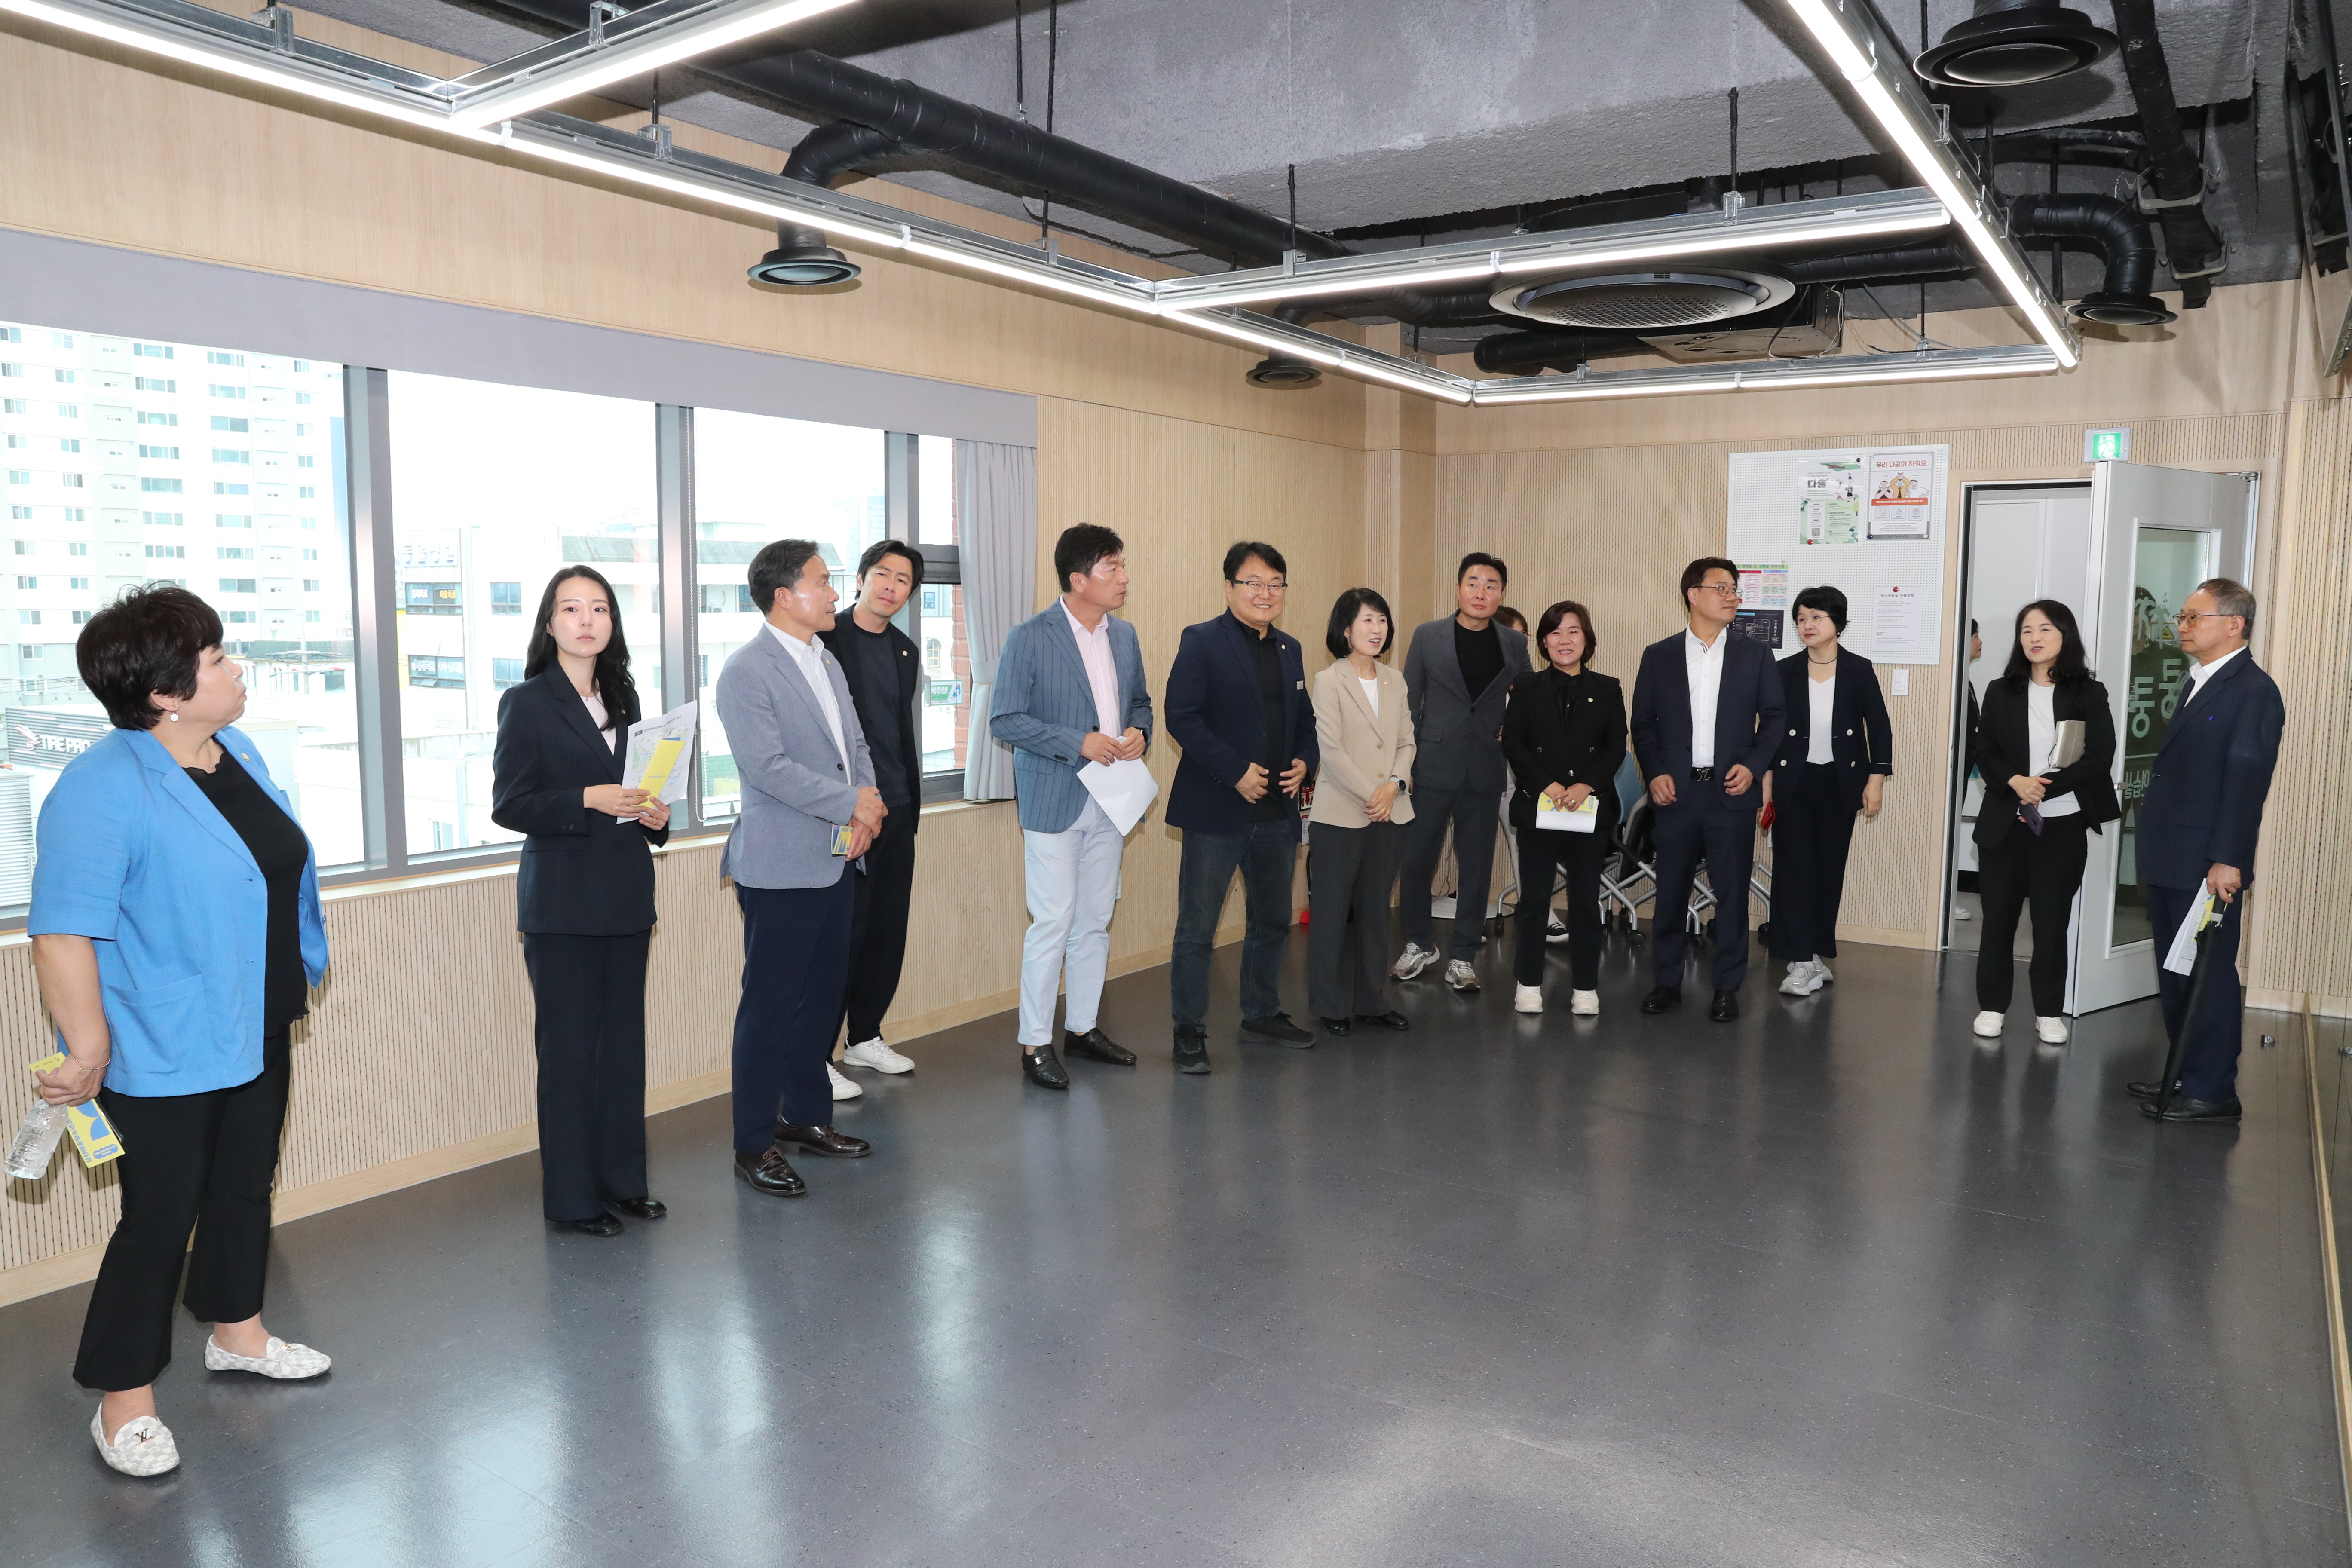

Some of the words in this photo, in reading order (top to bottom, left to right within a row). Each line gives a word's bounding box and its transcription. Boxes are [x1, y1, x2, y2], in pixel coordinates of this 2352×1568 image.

[401, 543, 455, 564] 동물병원
[439, 590, 456, 599] 미술치료
[931, 686, 948, 695] 락주의!
[40, 735, 66, 752] TIRE
